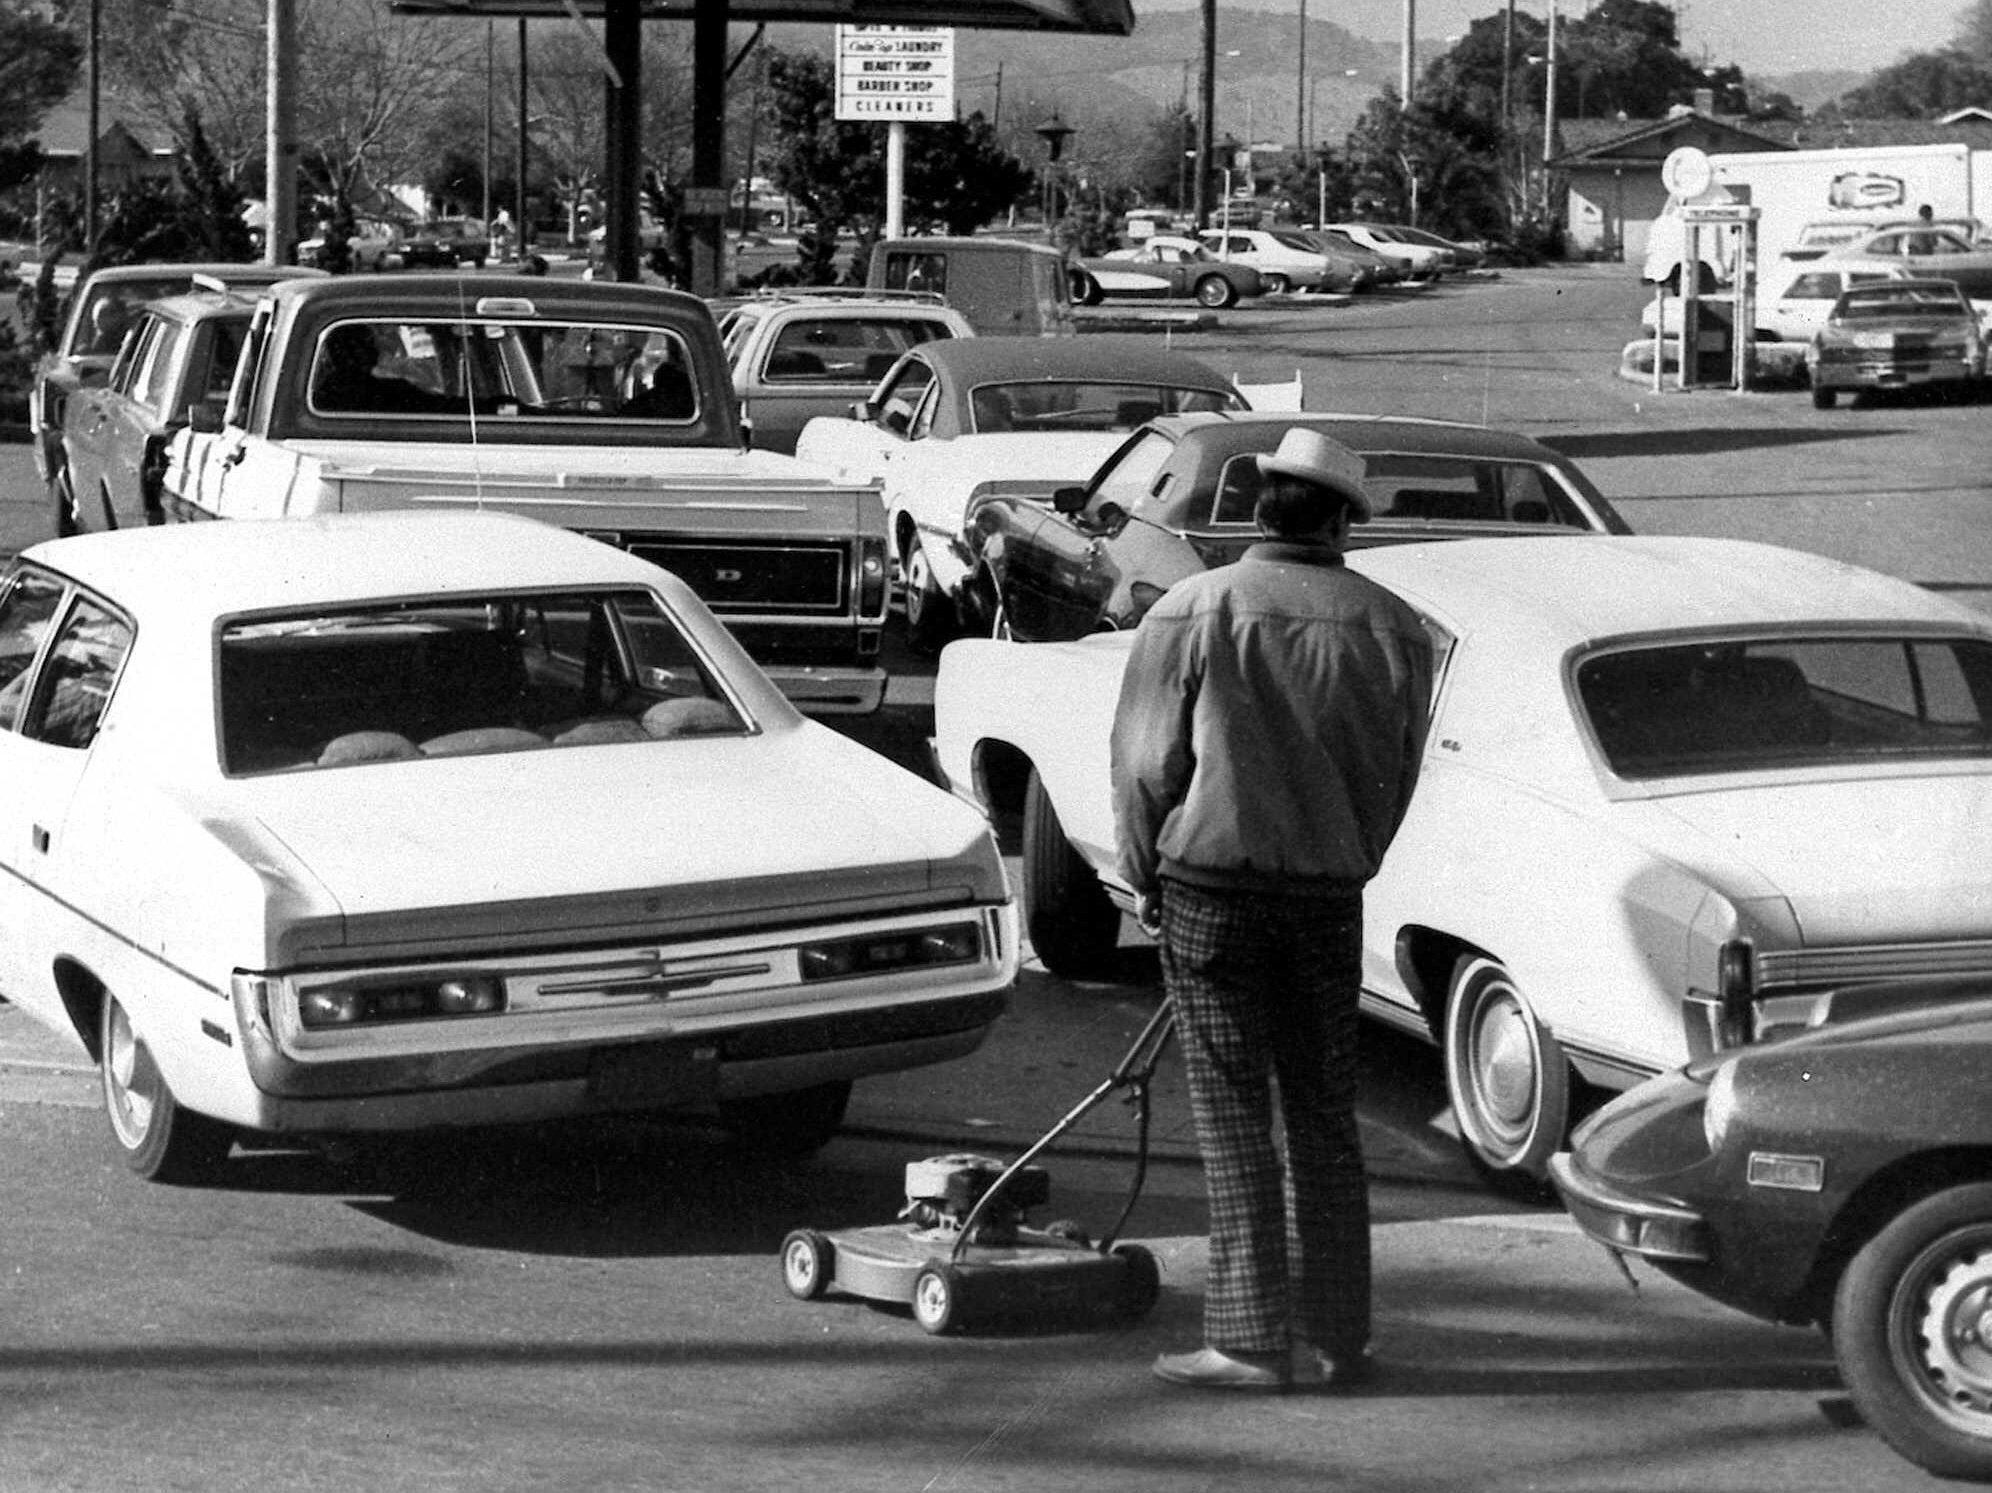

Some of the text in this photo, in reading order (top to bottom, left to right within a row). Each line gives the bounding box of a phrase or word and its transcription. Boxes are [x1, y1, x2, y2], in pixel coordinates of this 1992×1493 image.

[895, 41, 942, 52] LAUNDRY
[863, 61, 932, 72] BEAUTY SHOP
[858, 81, 933, 92] BARBER SHOP
[856, 101, 934, 112] CLEANERS
